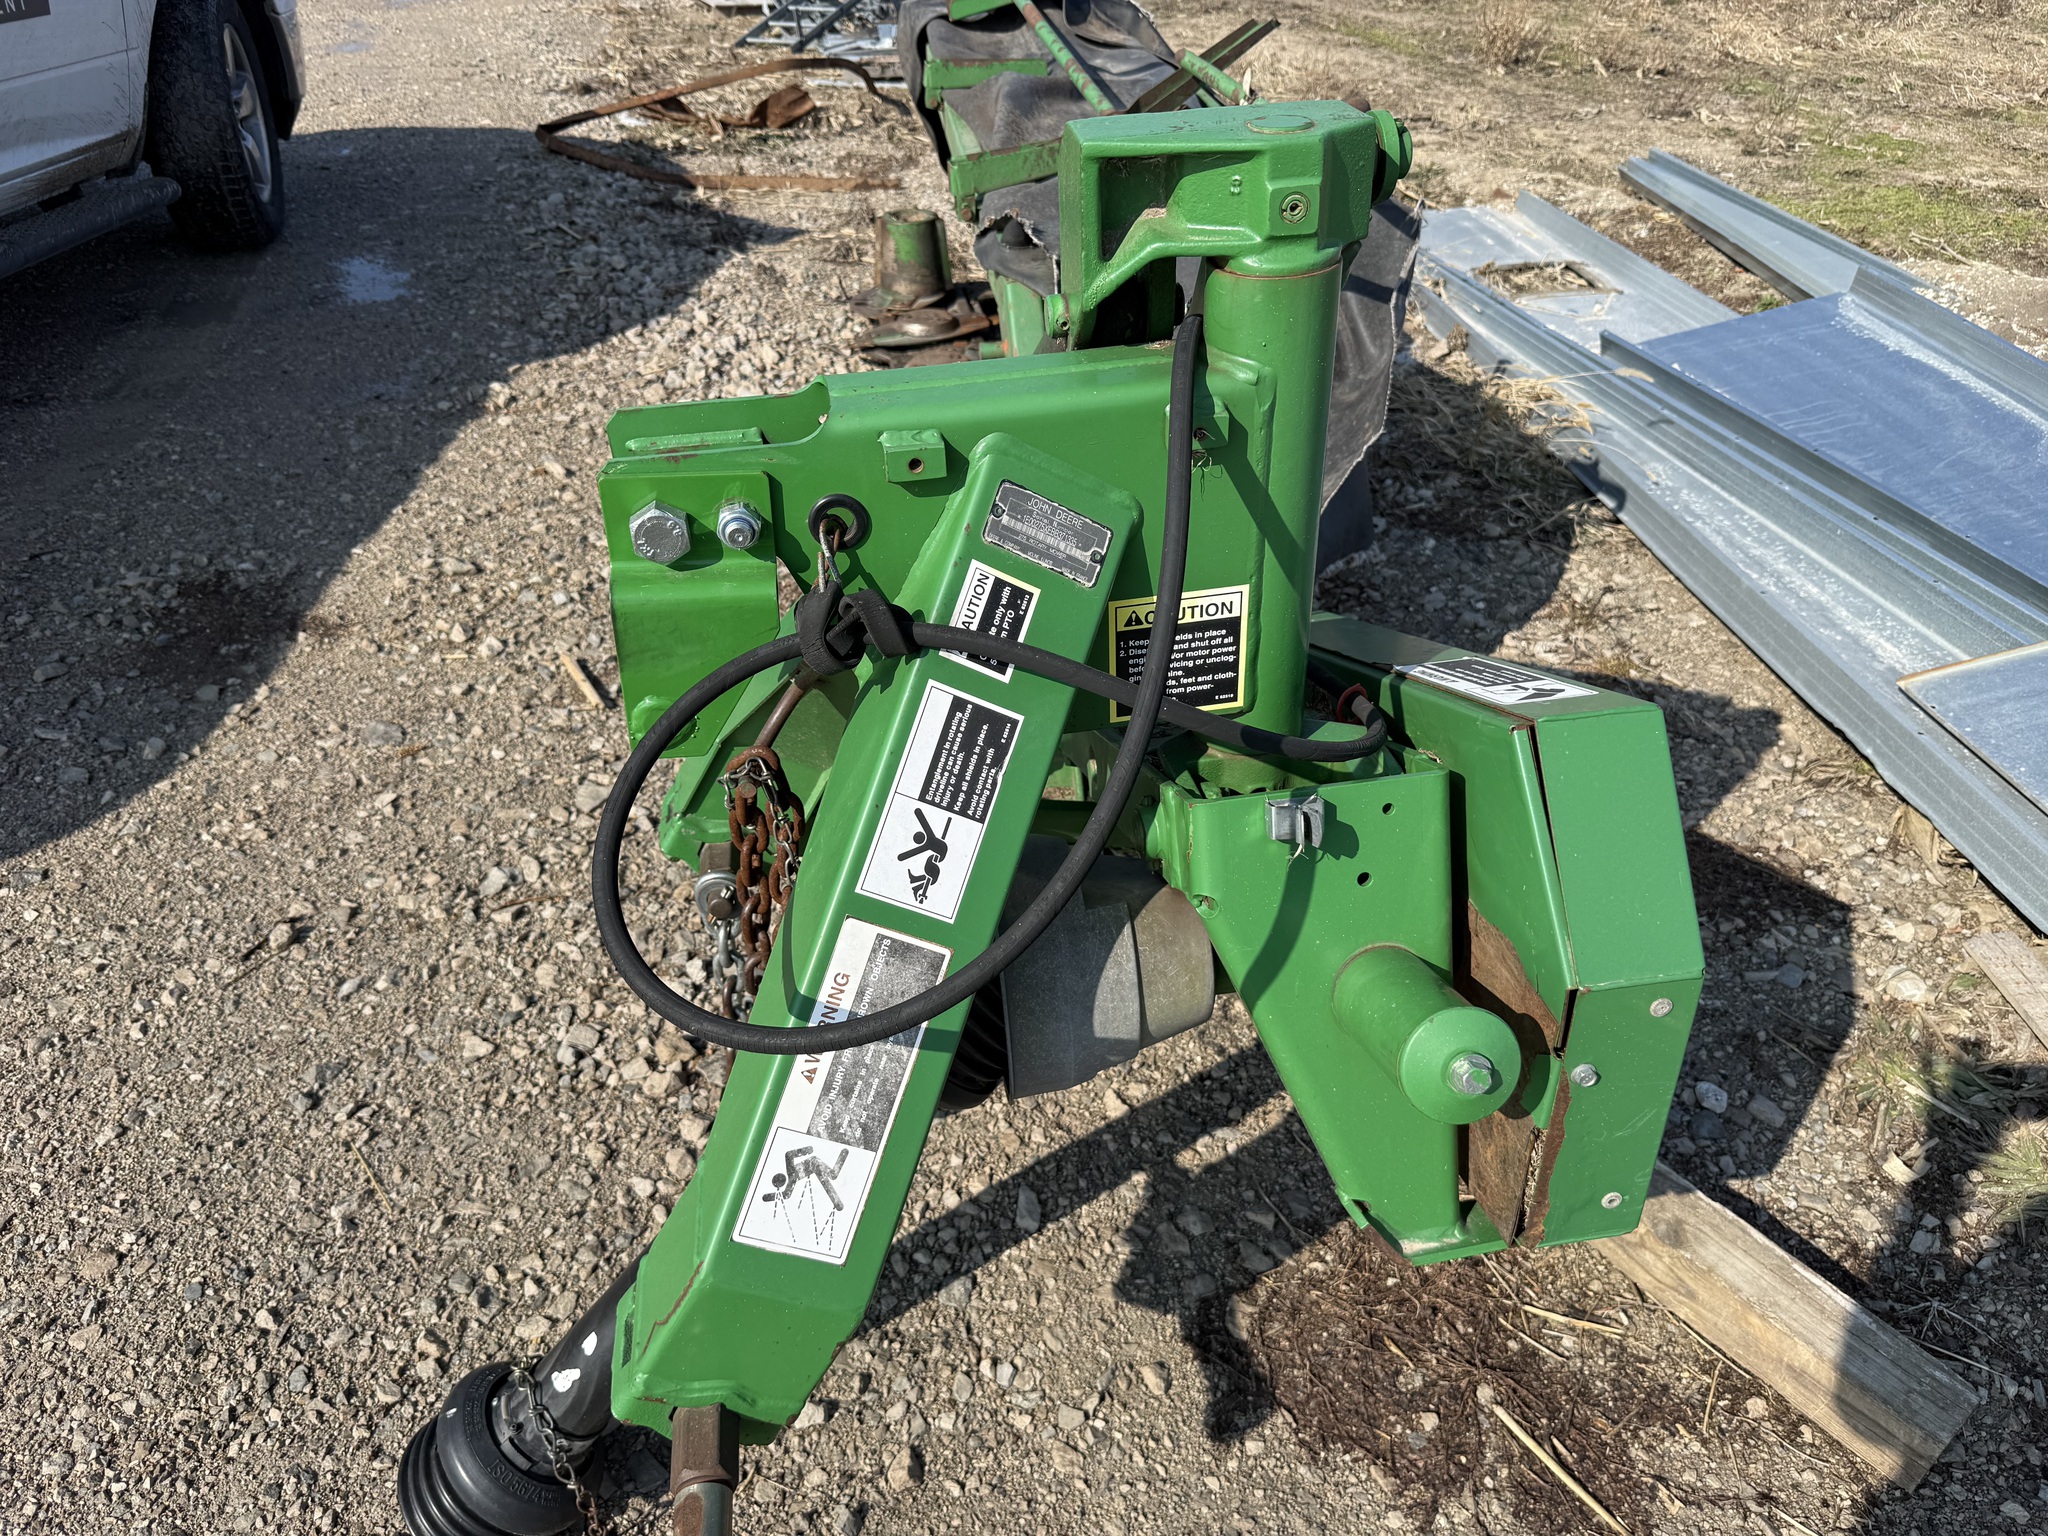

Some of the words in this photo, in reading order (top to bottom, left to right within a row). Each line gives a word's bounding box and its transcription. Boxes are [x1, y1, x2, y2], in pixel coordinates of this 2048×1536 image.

[1026, 496, 1052, 514] JOHN
[1055, 509, 1083, 529] DEERE
[960, 572, 989, 630] AUTION
[998, 585, 1011, 606] with
[991, 604, 1006, 626] only
[1002, 608, 1015, 629] PTO
[1144, 600, 1233, 624] CUTION
[1129, 638, 1149, 647] Keep
[1204, 628, 1226, 638] place
[1190, 639, 1208, 647] shut
[1186, 648, 1209, 657] motor
[1212, 645, 1236, 654] power
[1206, 653, 1236, 664] unclog-
[1214, 670, 1236, 679] cloth-
[1186, 683, 1214, 692] power-
[946, 710, 962, 741] rotating
[976, 722, 990, 745] place.
[933, 770, 949, 803] driveline
[945, 755, 954, 770] can
[951, 732, 962, 755] cause
[958, 703, 972, 731] serious
[943, 740, 950, 748] in
[973, 745, 980, 753] in
[951, 749, 965, 774] death.
[963, 753, 978, 780] shields
[925, 748, 949, 801] Entanglement
[949, 775, 956, 784] or
[966, 794, 978, 815] Avoid
[974, 765, 988, 794] contact
[984, 747, 995, 764] with
[940, 784, 954, 807] injury
[960, 780, 968, 791] all
[974, 788, 990, 819] rotating
[984, 765, 998, 788] parts.
[953, 791, 966, 811] Keep
[816, 1103, 833, 1133] AVOID
[827, 1065, 846, 1099] INJURY
[869, 937, 891, 980] OBJECTS
[877, 1053, 888, 1069] near
[838, 1114, 851, 1133] Keep
[847, 1079, 863, 1108] curtains
[859, 1067, 867, 1075] in
[864, 1077, 881, 1104] operate
[857, 1109, 868, 1122] not
[853, 1127, 862, 1137] do
